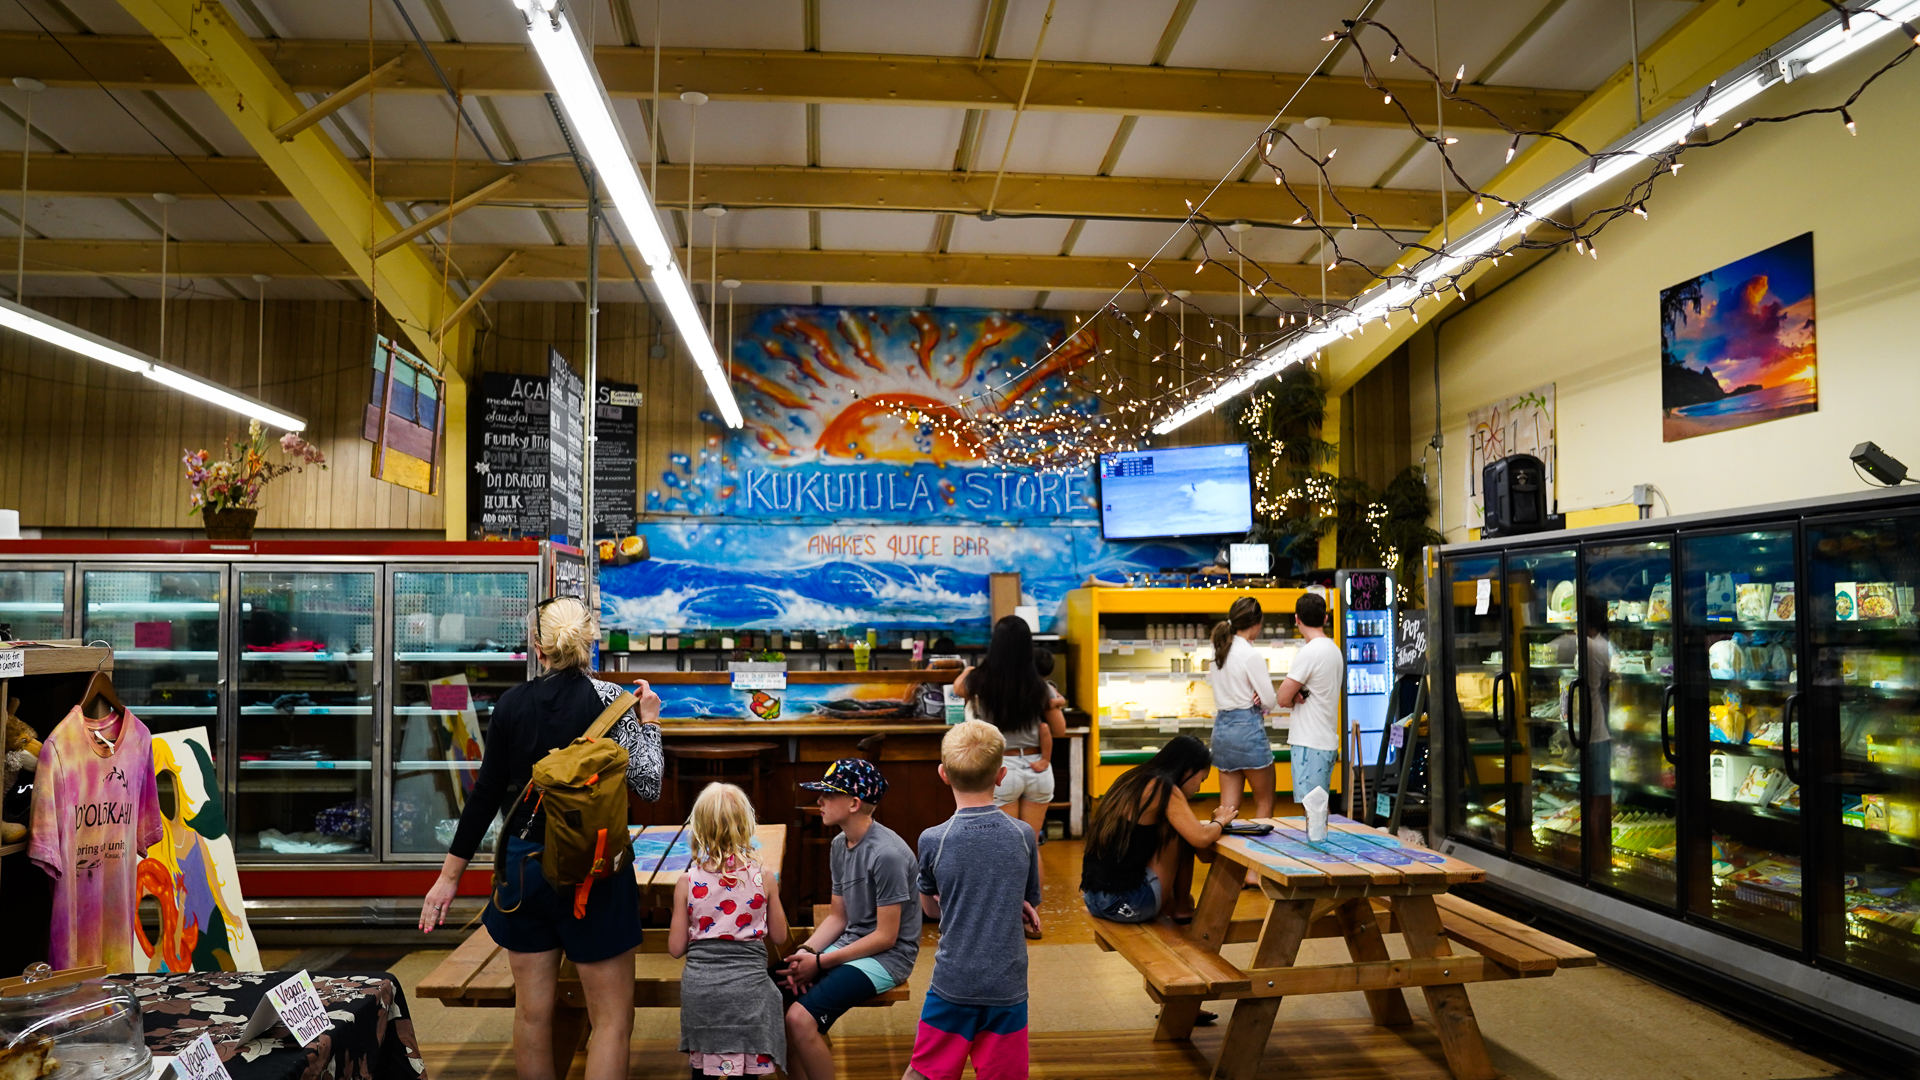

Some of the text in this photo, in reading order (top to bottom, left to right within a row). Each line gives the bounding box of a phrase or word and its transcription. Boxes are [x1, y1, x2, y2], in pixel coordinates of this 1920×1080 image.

[484, 432, 529, 450] Funky
[487, 472, 502, 488] DA
[747, 470, 1089, 515] KUKUIULA STORE
[484, 495, 523, 509] HULK
[807, 534, 876, 556] ANAKE'S
[953, 535, 990, 556] BAR
[1351, 573, 1378, 589] GRAB
[1354, 598, 1371, 610] GO
[1402, 619, 1420, 641] Pop
[1397, 648, 1417, 666] Shop
[77, 844, 99, 856] bring
[275, 981, 306, 1005] Vegan
[281, 996, 320, 1028] Banana
[178, 1042, 211, 1077] Vegan
